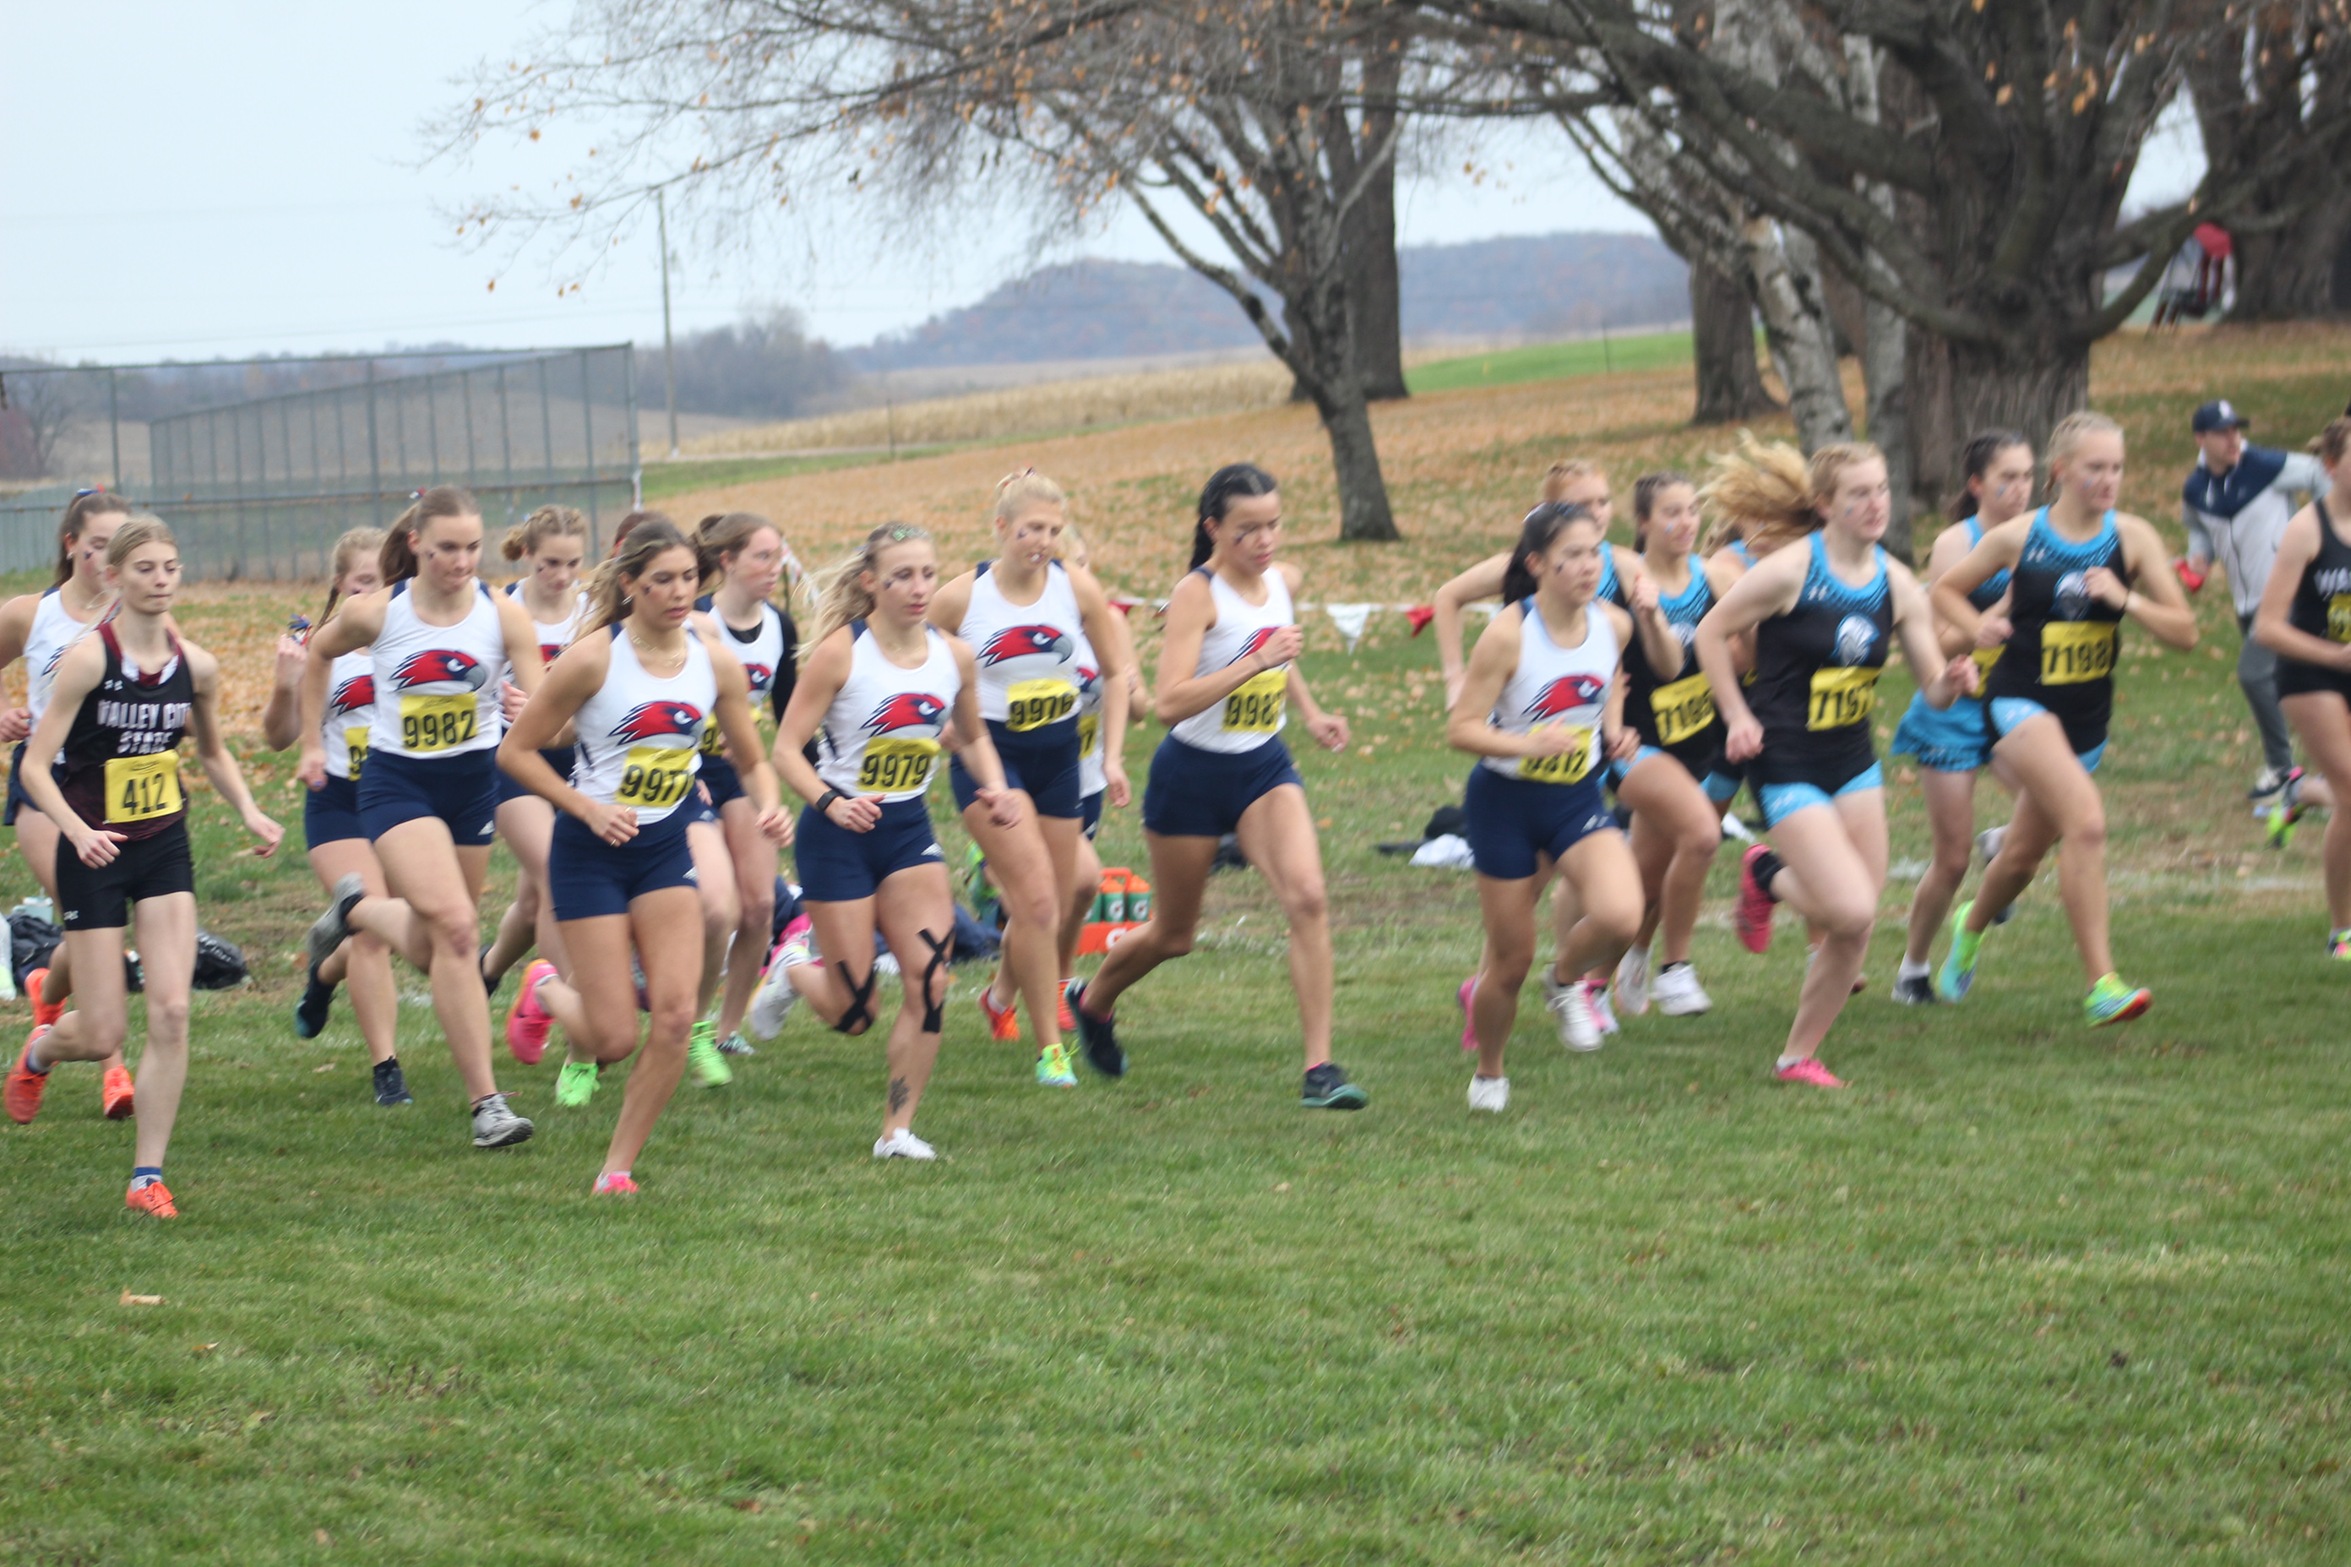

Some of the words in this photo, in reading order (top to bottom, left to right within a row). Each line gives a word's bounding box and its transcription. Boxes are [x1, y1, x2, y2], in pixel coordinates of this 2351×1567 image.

[97, 699, 160, 729] VALLEY
[163, 702, 192, 730] CIT
[404, 709, 476, 747] 9982
[117, 731, 174, 754] STATE
[861, 754, 930, 786] 9979
[122, 772, 169, 815] 412
